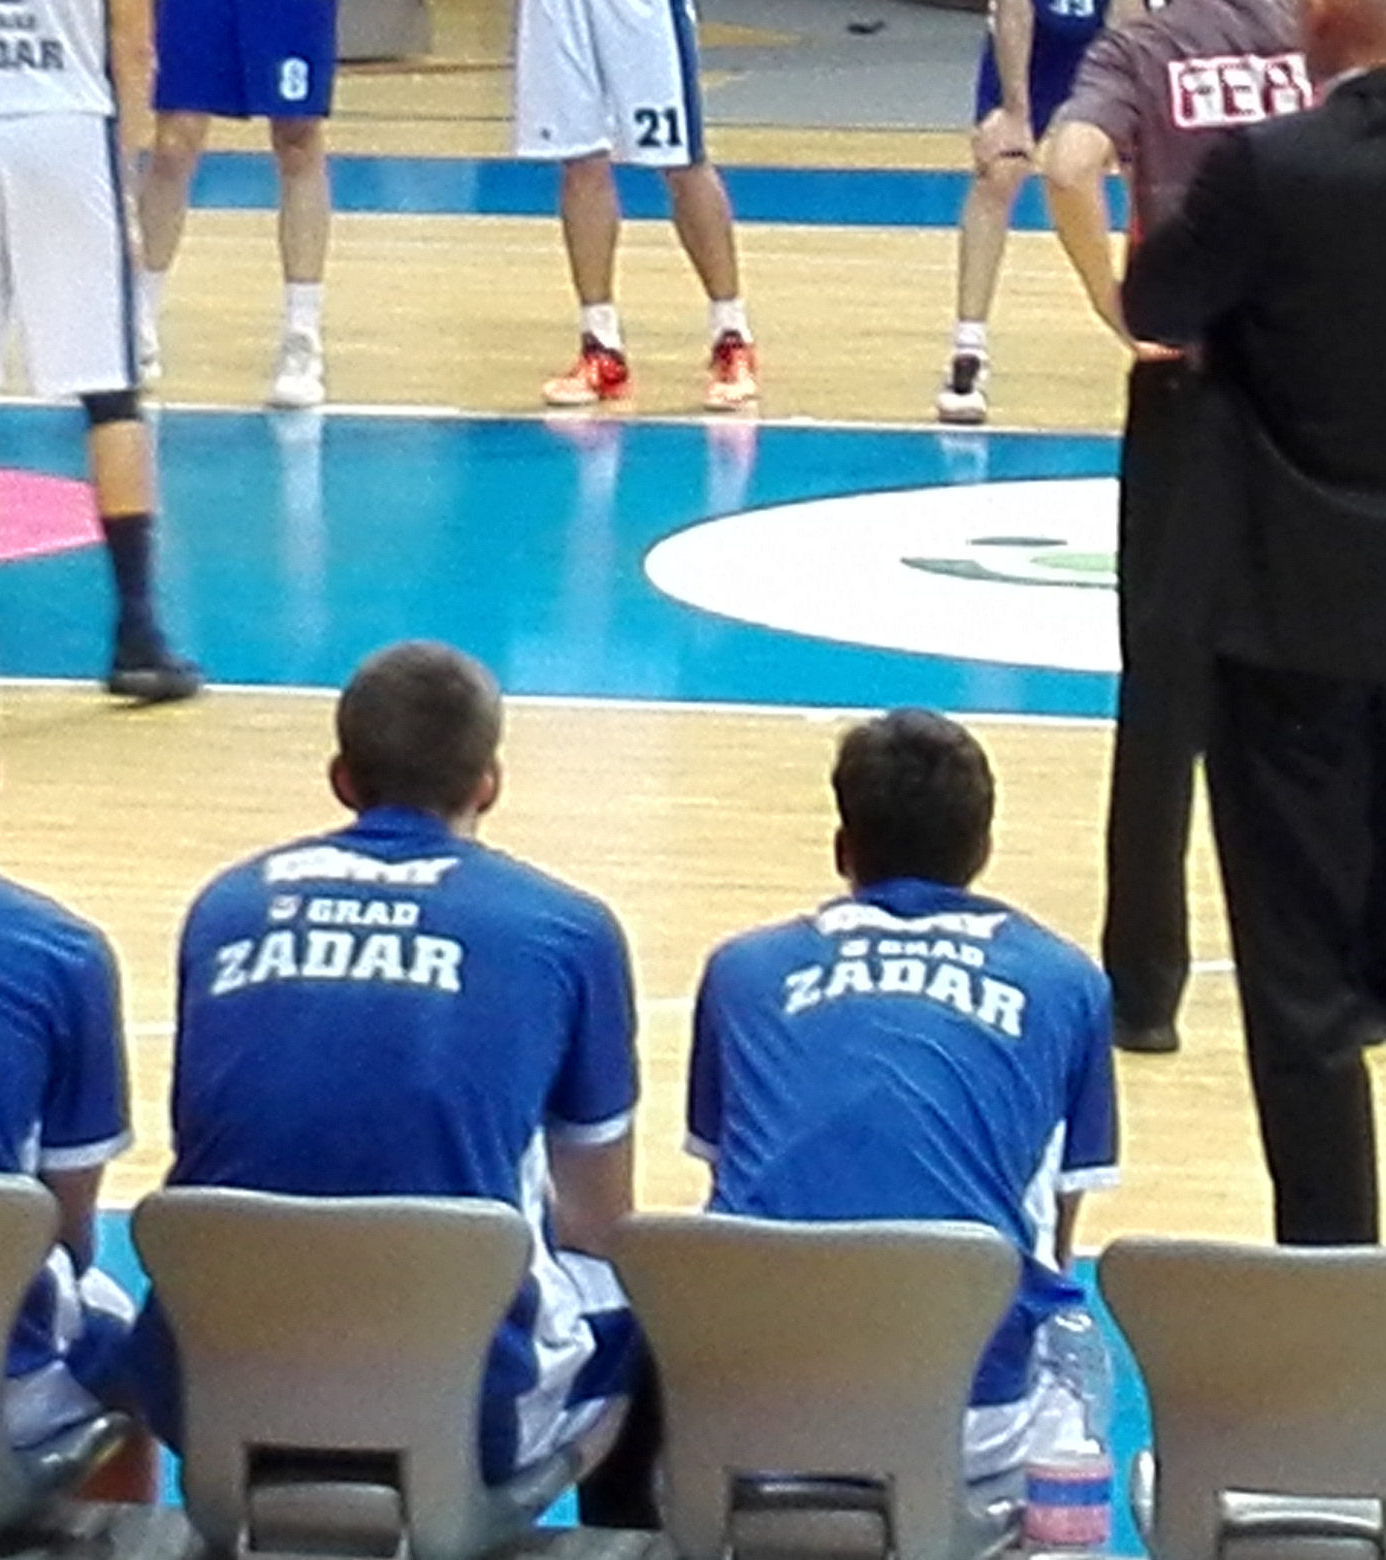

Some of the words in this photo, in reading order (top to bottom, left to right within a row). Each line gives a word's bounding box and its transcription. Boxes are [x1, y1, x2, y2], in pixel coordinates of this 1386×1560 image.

[634, 108, 681, 147] 21
[307, 897, 421, 927] GRAD
[212, 929, 464, 995] ZADAR
[782, 957, 1027, 1038] ZADAR
